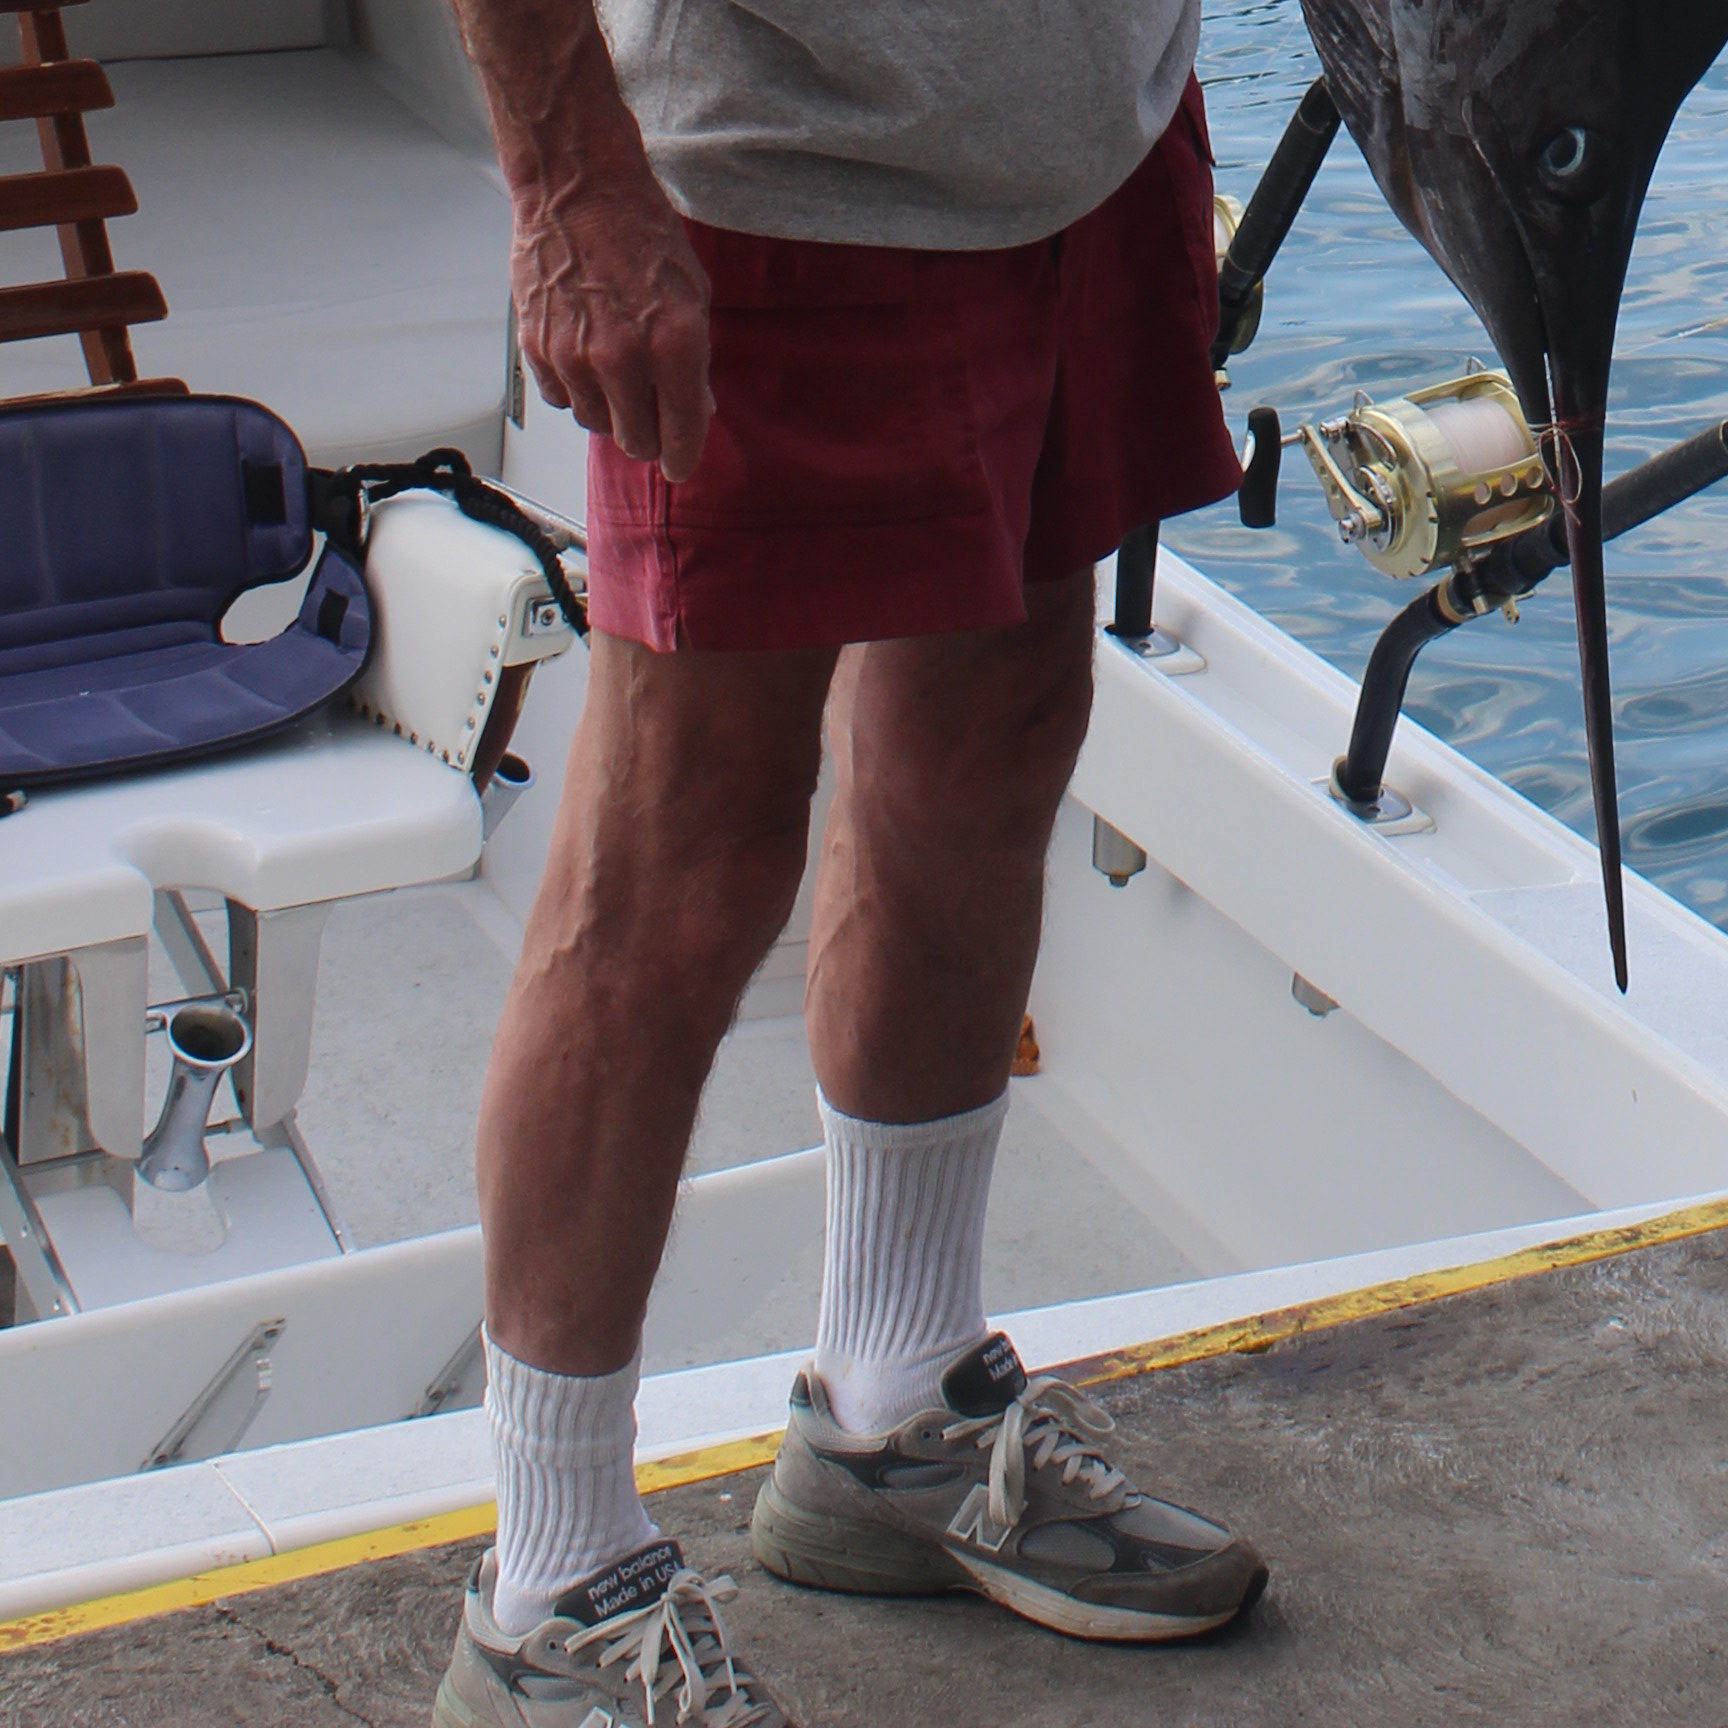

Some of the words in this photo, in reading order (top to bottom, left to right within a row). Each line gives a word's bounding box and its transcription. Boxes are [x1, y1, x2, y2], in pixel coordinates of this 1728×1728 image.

[587, 1572, 619, 1601] new
[594, 1585, 638, 1618] Made
[640, 1575, 656, 1592] in
